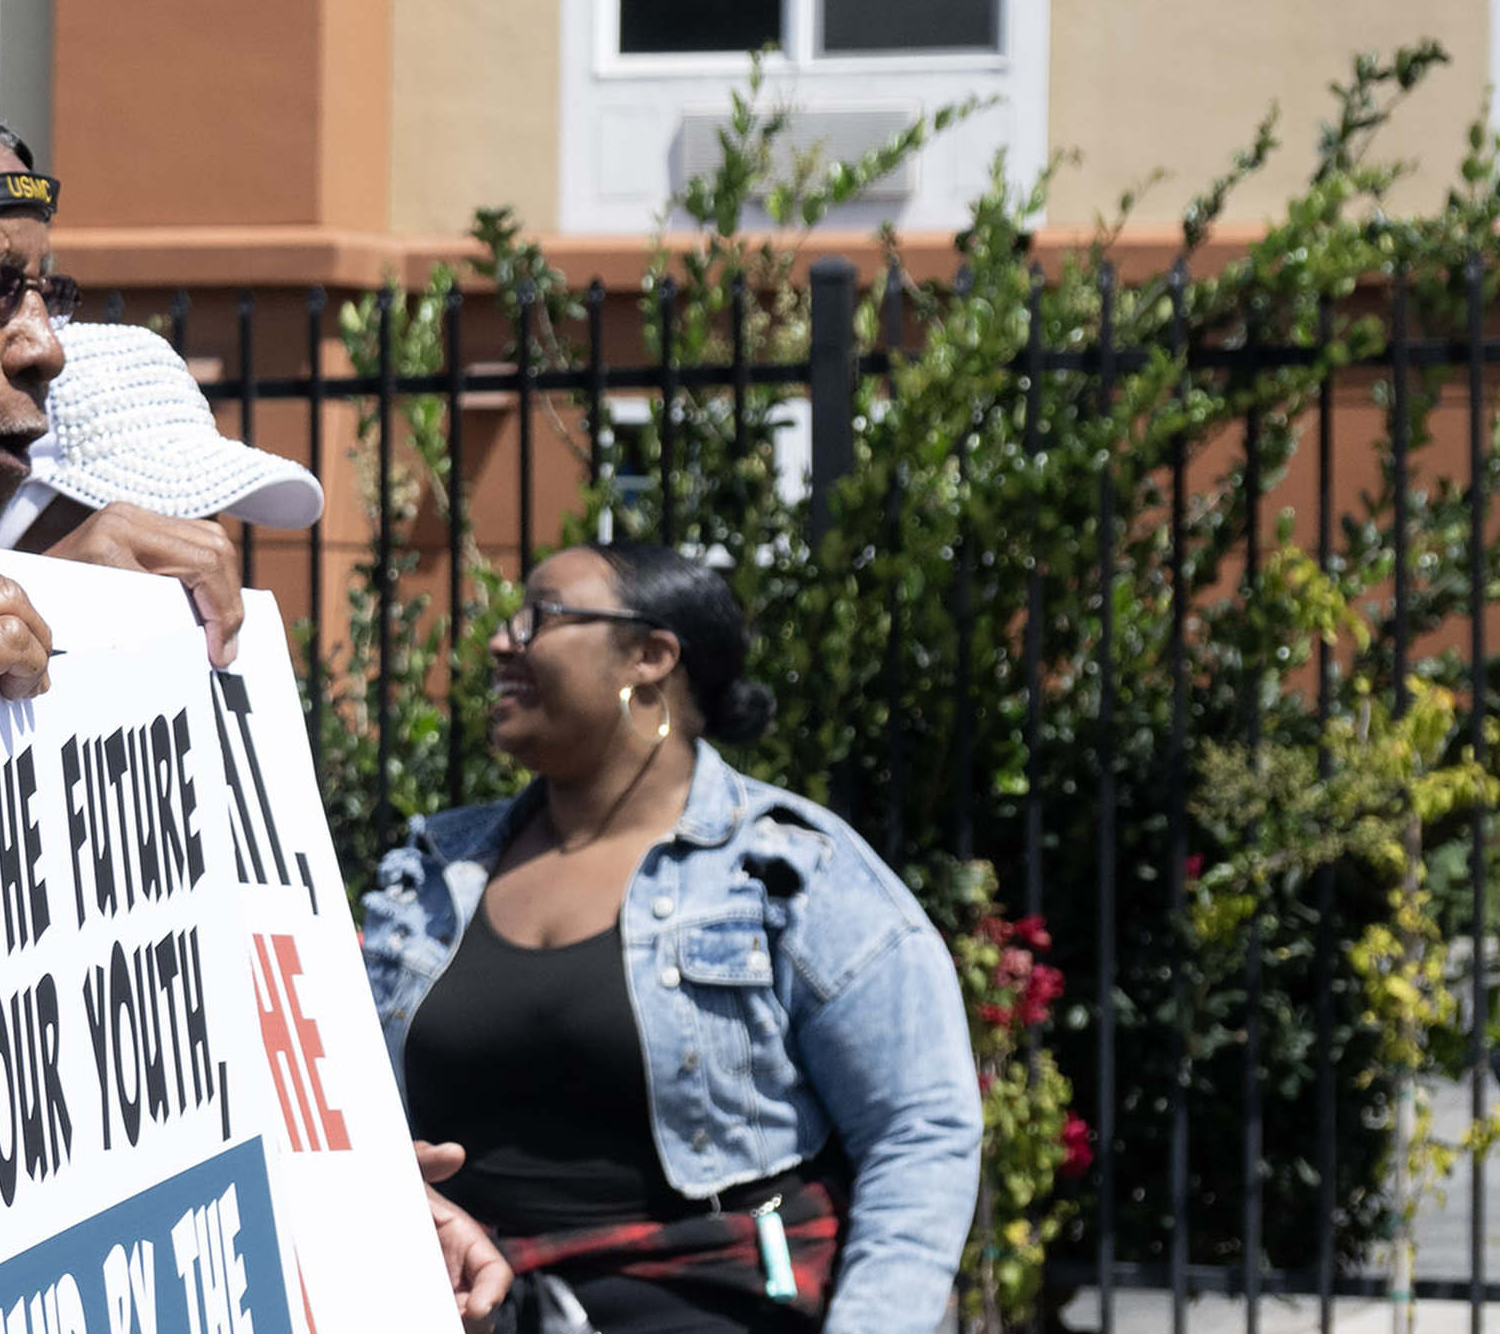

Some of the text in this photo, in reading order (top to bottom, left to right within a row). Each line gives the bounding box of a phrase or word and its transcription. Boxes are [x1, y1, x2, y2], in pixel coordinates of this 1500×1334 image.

[5, 174, 51, 203] USMC
[61, 707, 205, 930] FUTURE
[83, 925, 232, 1151] YOUTH,
